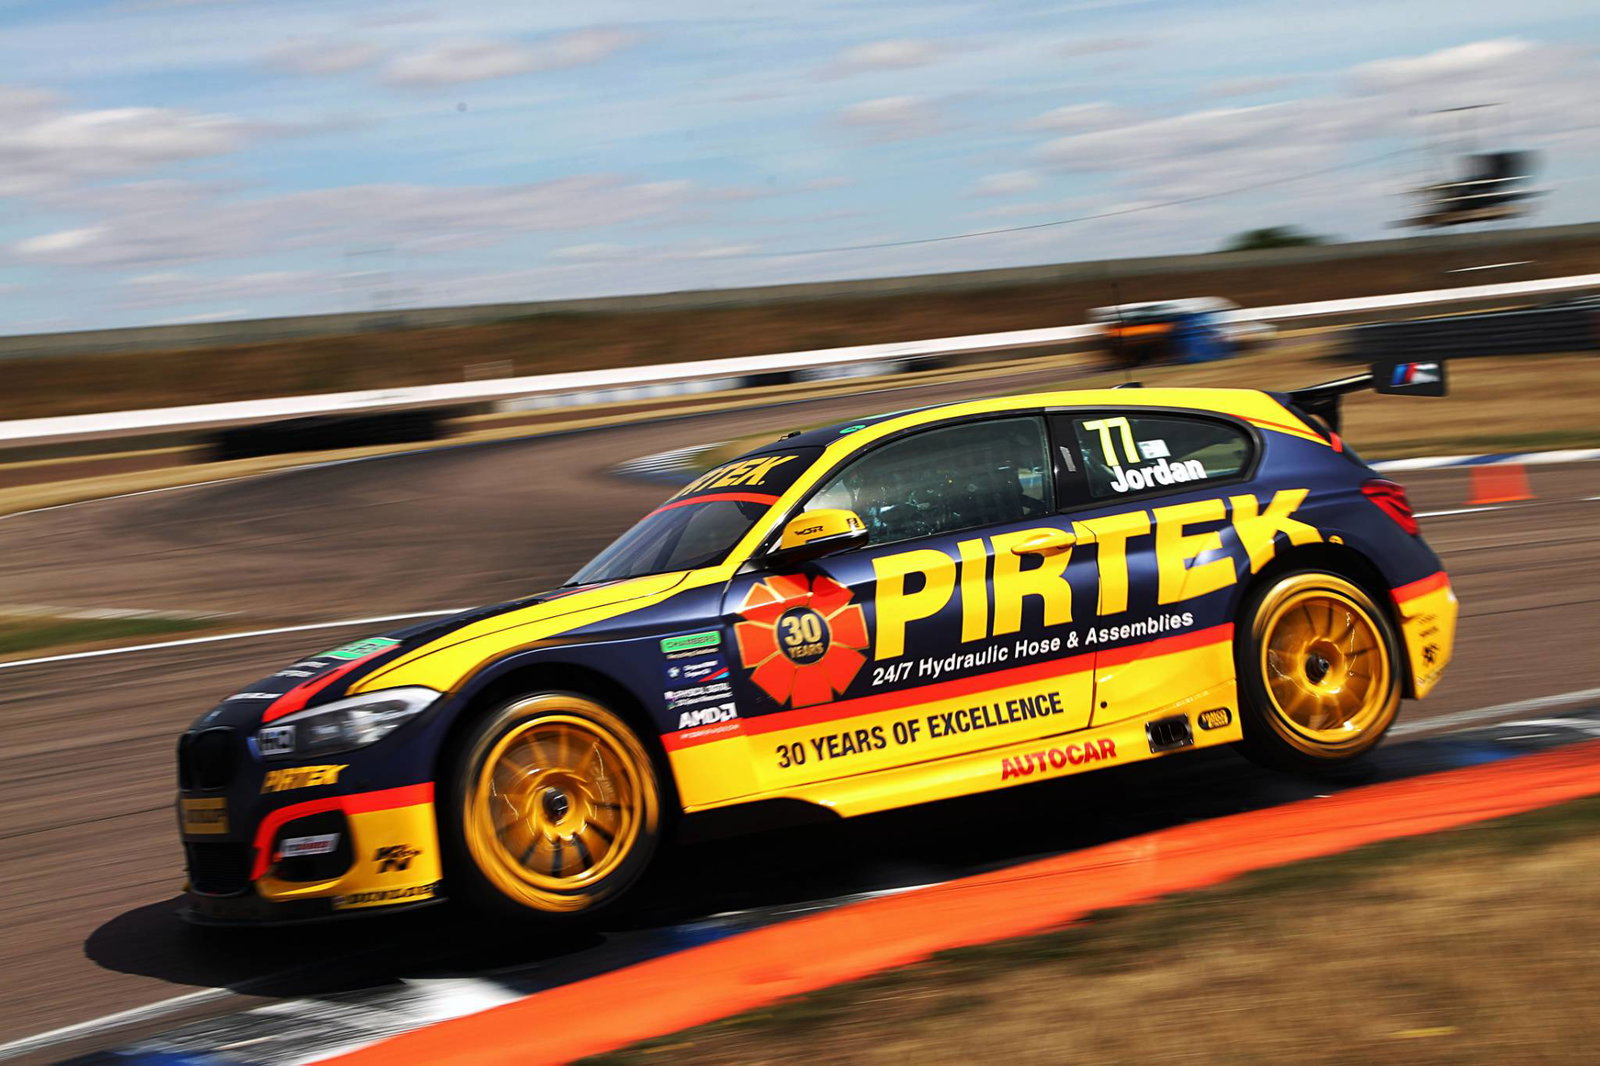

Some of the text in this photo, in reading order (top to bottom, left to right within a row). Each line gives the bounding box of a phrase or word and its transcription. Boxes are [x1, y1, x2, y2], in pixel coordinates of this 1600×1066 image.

[1082, 416, 1141, 467] 77
[1110, 458, 1208, 493] Jordan
[871, 488, 1324, 662] PIRTEK
[781, 613, 822, 646] 30
[788, 643, 824, 659] YEARS
[871, 611, 1194, 686] 24/7 Hydraulic Hose & Assemblies
[776, 691, 1064, 768] 30 YEARS OF EXCELLENCE
[1001, 738, 1117, 781] AUTOCAR
